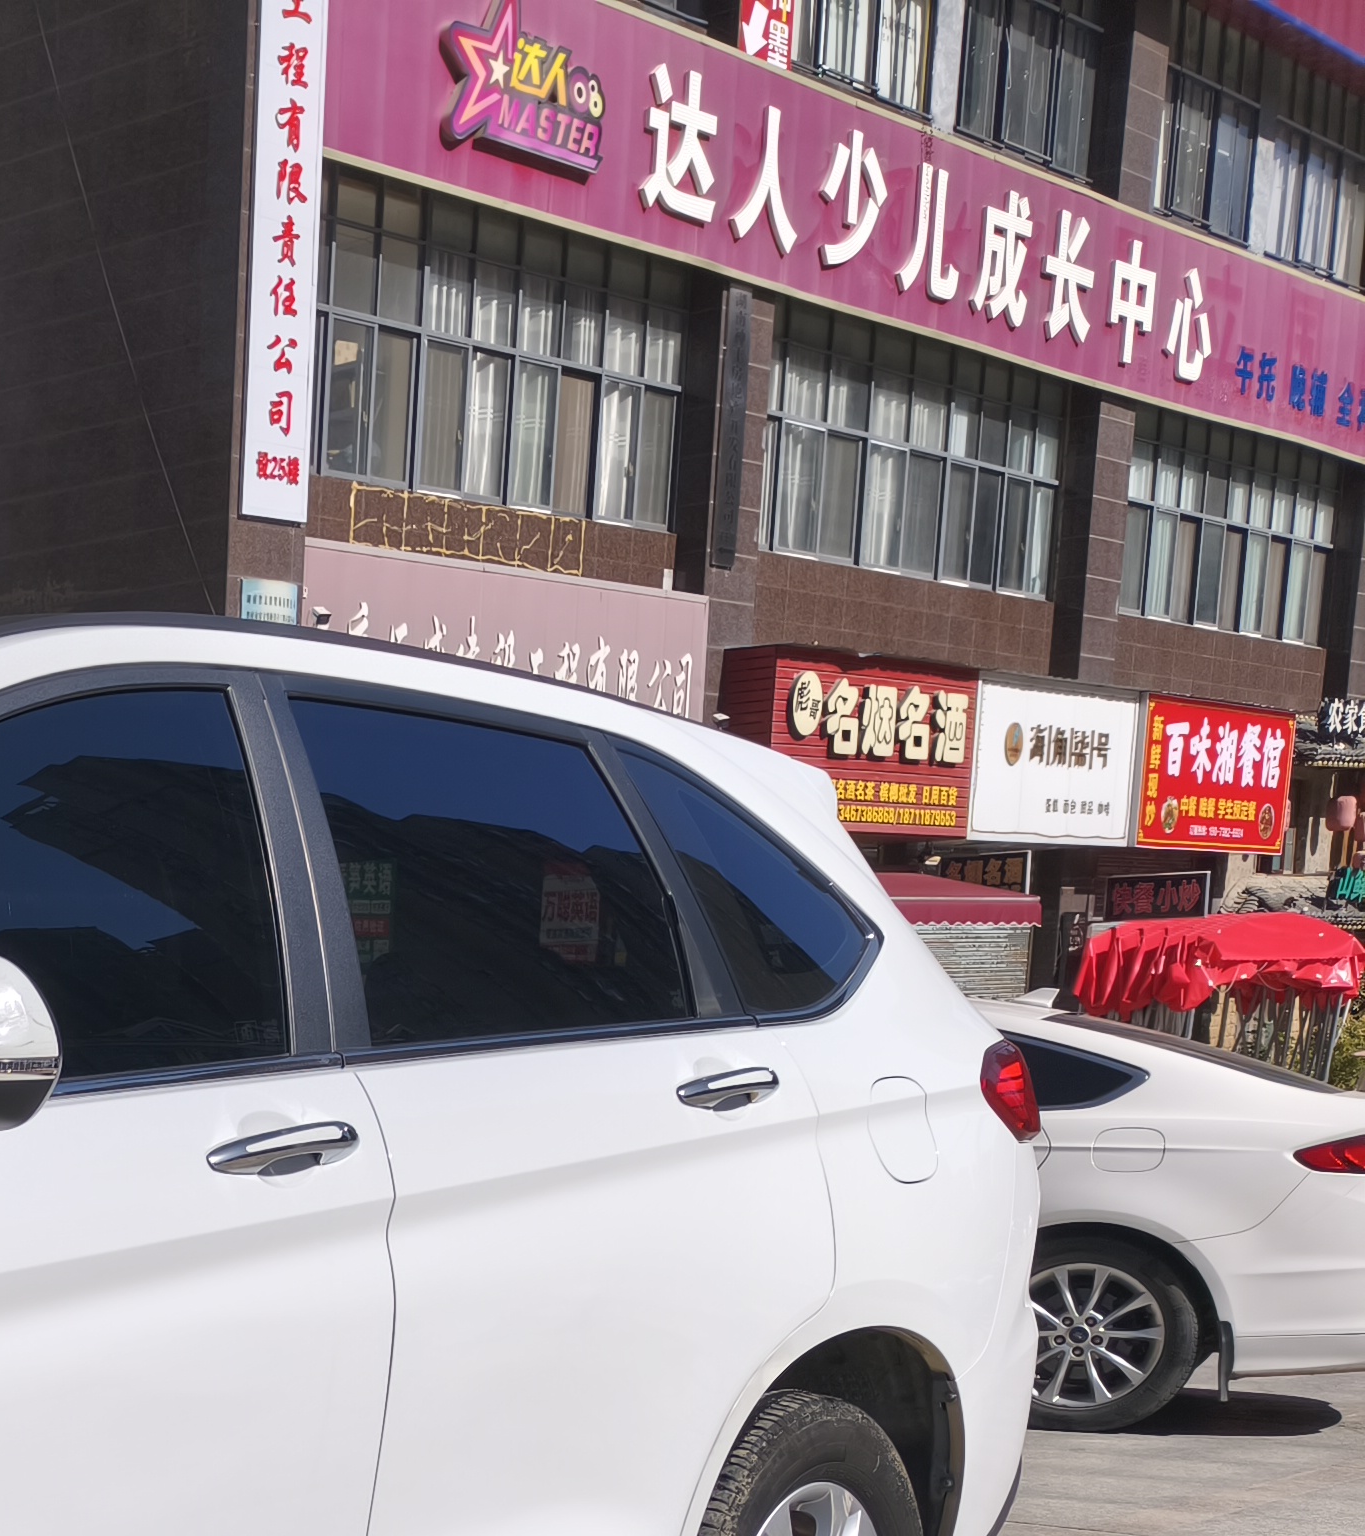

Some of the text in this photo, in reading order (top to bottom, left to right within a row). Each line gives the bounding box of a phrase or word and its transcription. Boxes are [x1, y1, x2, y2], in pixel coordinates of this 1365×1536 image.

[510, 38, 567, 107] 达人
[498, 94, 601, 157] MASTER
[266, 0, 312, 438] 工程有限责任公司
[639, 63, 1213, 383] 达人少儿成长中心
[826, 677, 970, 764] 名烟名酒
[1165, 716, 1286, 790] 百味湘餐馆
[1144, 715, 1165, 828] 新鲜现炒
[1180, 795, 1198, 817] 中餐
[838, 805, 956, 827] 3467386868/18711879553
[1112, 878, 1202, 915] 快餐小炒
